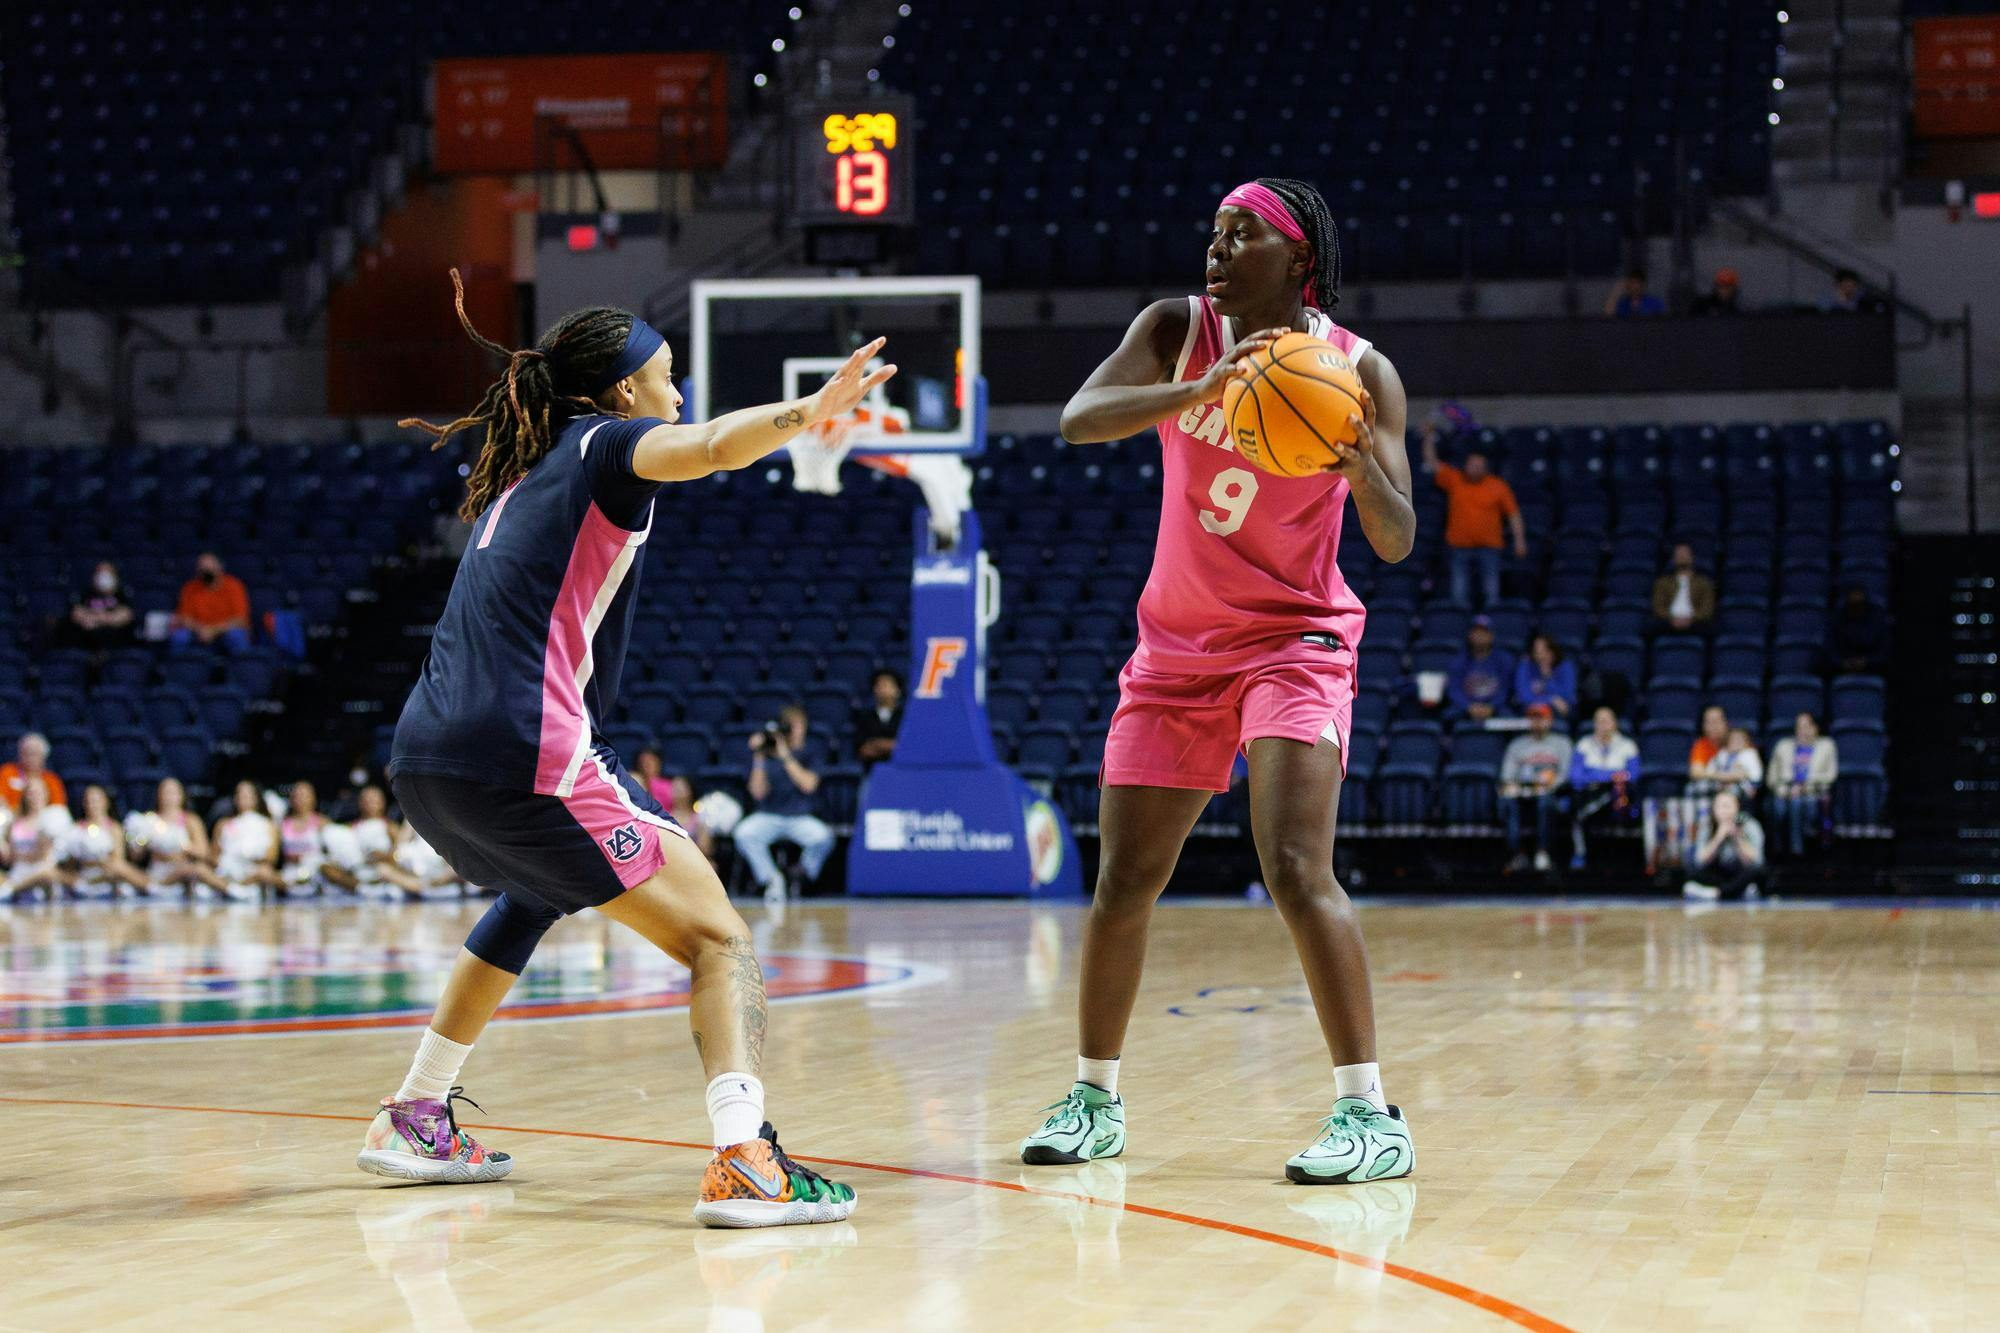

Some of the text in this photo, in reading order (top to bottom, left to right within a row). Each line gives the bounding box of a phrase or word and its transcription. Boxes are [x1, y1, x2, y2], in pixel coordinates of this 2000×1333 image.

[824, 114, 896, 153] 5:29
[837, 152, 888, 215] 13
[1199, 467, 1259, 537] 9
[915, 637, 967, 698] F
